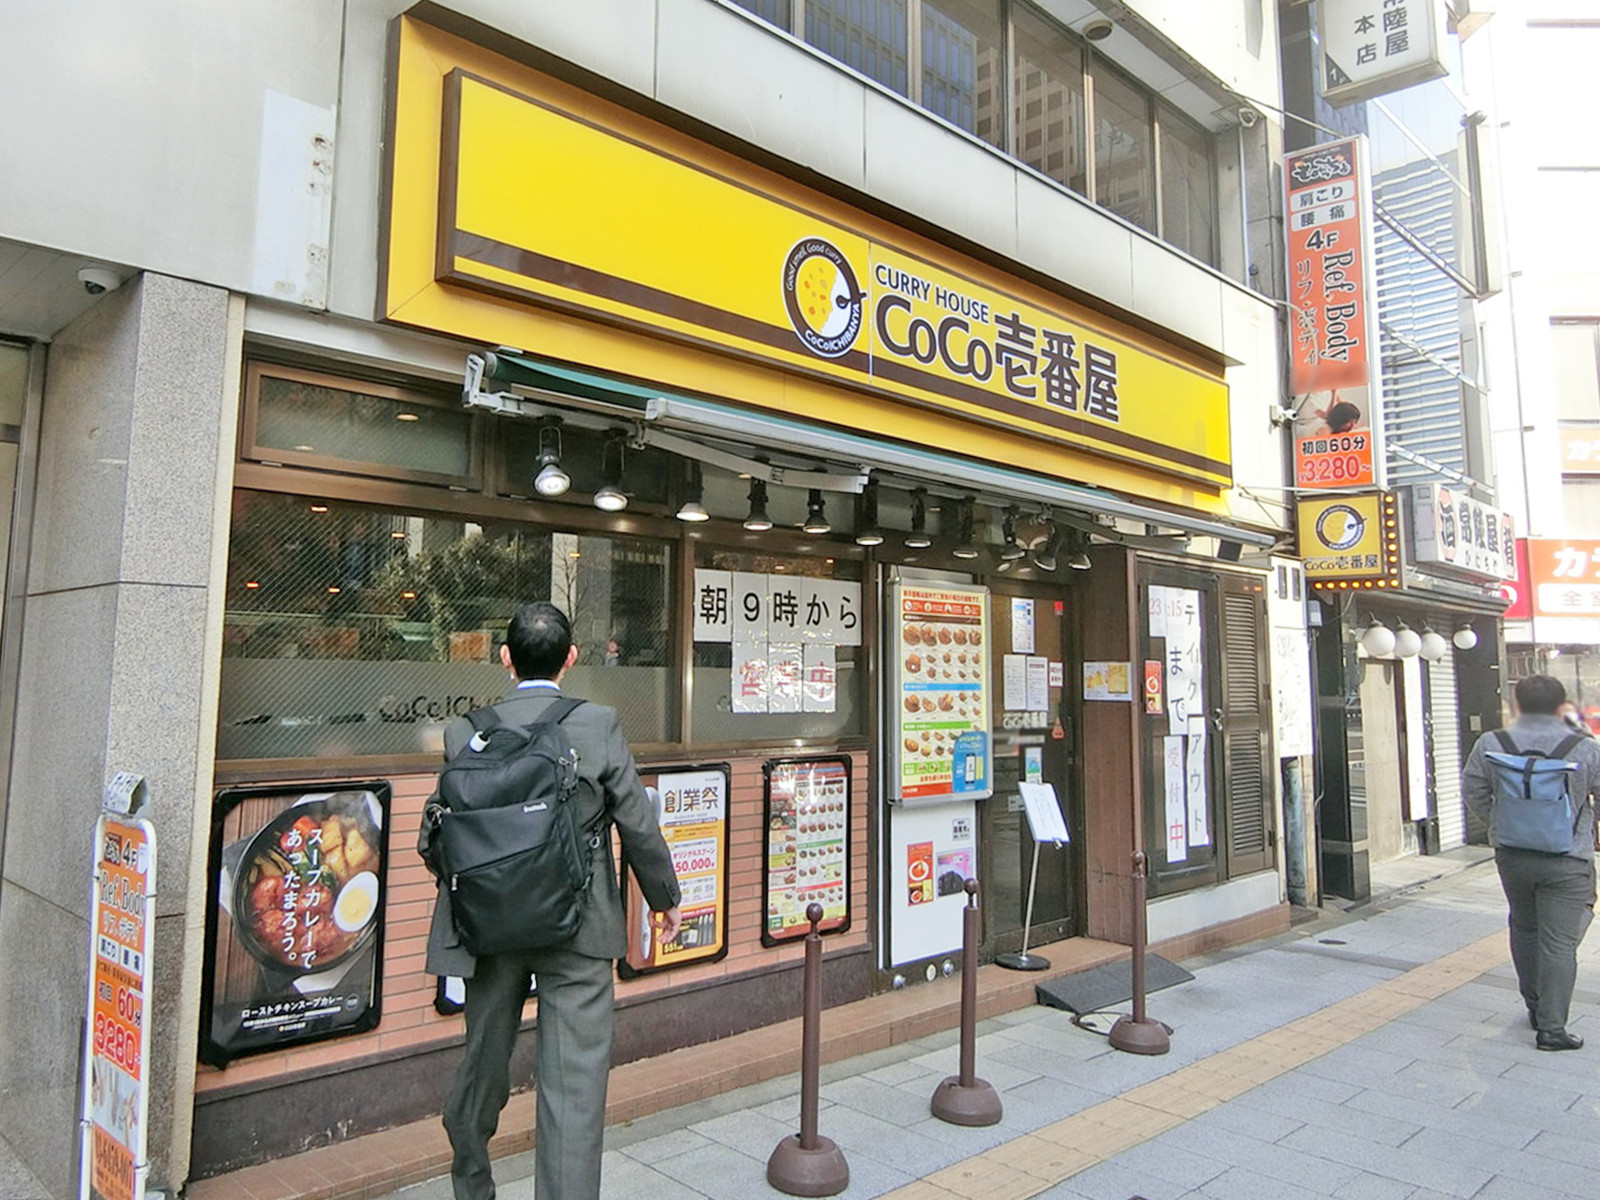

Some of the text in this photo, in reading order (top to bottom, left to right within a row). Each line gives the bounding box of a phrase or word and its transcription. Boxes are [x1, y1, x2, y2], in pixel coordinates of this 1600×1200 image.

[1354, 15, 1377, 66] 本店
[1300, 186, 1343, 208] 肩こり
[1306, 229, 1339, 250] 4F
[875, 263, 990, 325] CURRY HOUSE
[804, 302, 861, 351] CoCoICHIBANYA
[1321, 302, 1357, 362] Body
[875, 294, 1120, 424] CoCo壱番屋
[1302, 435, 1365, 455] 初回60分
[1566, 439, 1600, 462] カ
[1552, 547, 1600, 578] カ
[699, 585, 857, 629] 朝9時から
[1169, 646, 1186, 723] まで
[664, 787, 719, 813] 創業祭
[1167, 746, 1184, 850] 受付中
[122, 838, 138, 870] 4F
[121, 876, 145, 928] Body
[280, 828, 304, 963] あったまろう。
[301, 827, 324, 970] スープカレーで
